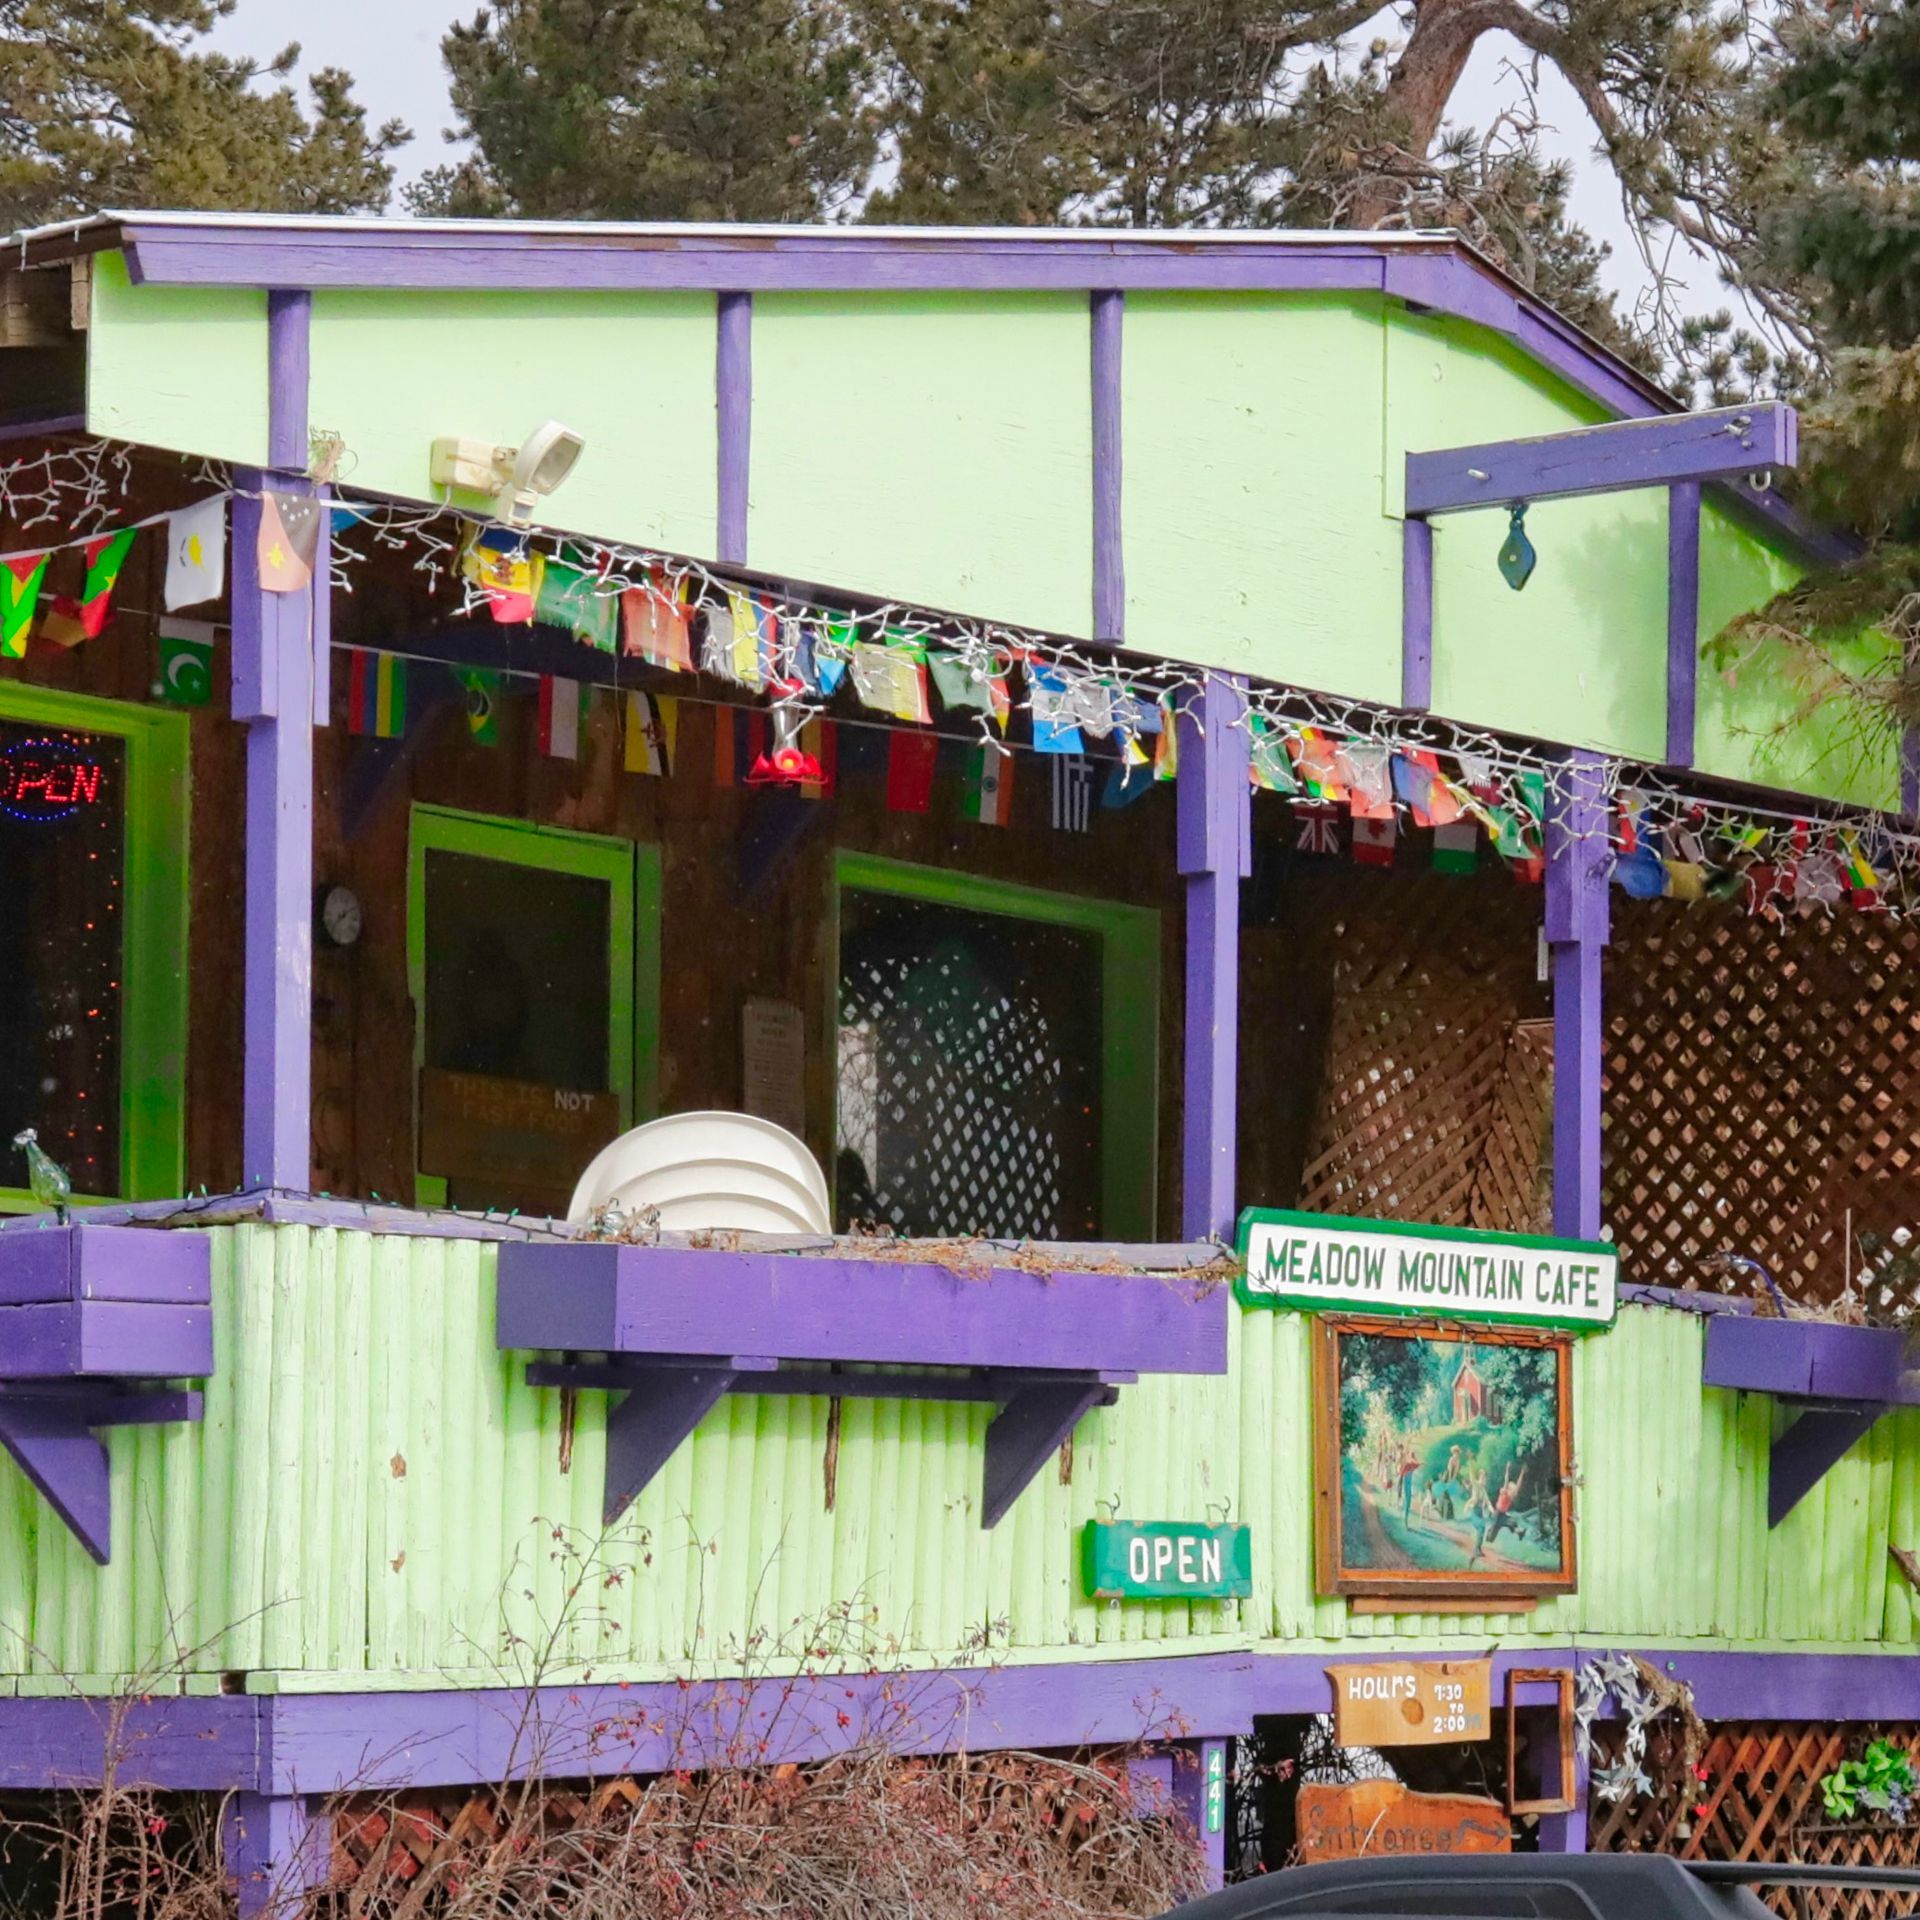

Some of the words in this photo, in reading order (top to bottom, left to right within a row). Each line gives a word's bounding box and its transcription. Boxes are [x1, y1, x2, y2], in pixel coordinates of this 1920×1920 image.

[448, 1074, 505, 1101] THIS
[519, 1086, 544, 1105] IS
[554, 1089, 596, 1112] NOT
[463, 1102, 518, 1124] FAST
[528, 1111, 584, 1134] FOOD
[1265, 1237, 1386, 1290] MEADOW
[1397, 1249, 1524, 1302] MOUNTAIN
[1536, 1261, 1600, 1307] CAFE
[1129, 1536, 1222, 1584] OPEN
[1433, 1684, 1462, 1701] 7:30
[1449, 1703, 1464, 1714] TO
[1433, 1715, 1465, 1733] 2:00
[1209, 1751, 1222, 1830] 441
[1309, 1804, 1451, 1852] Entrance
